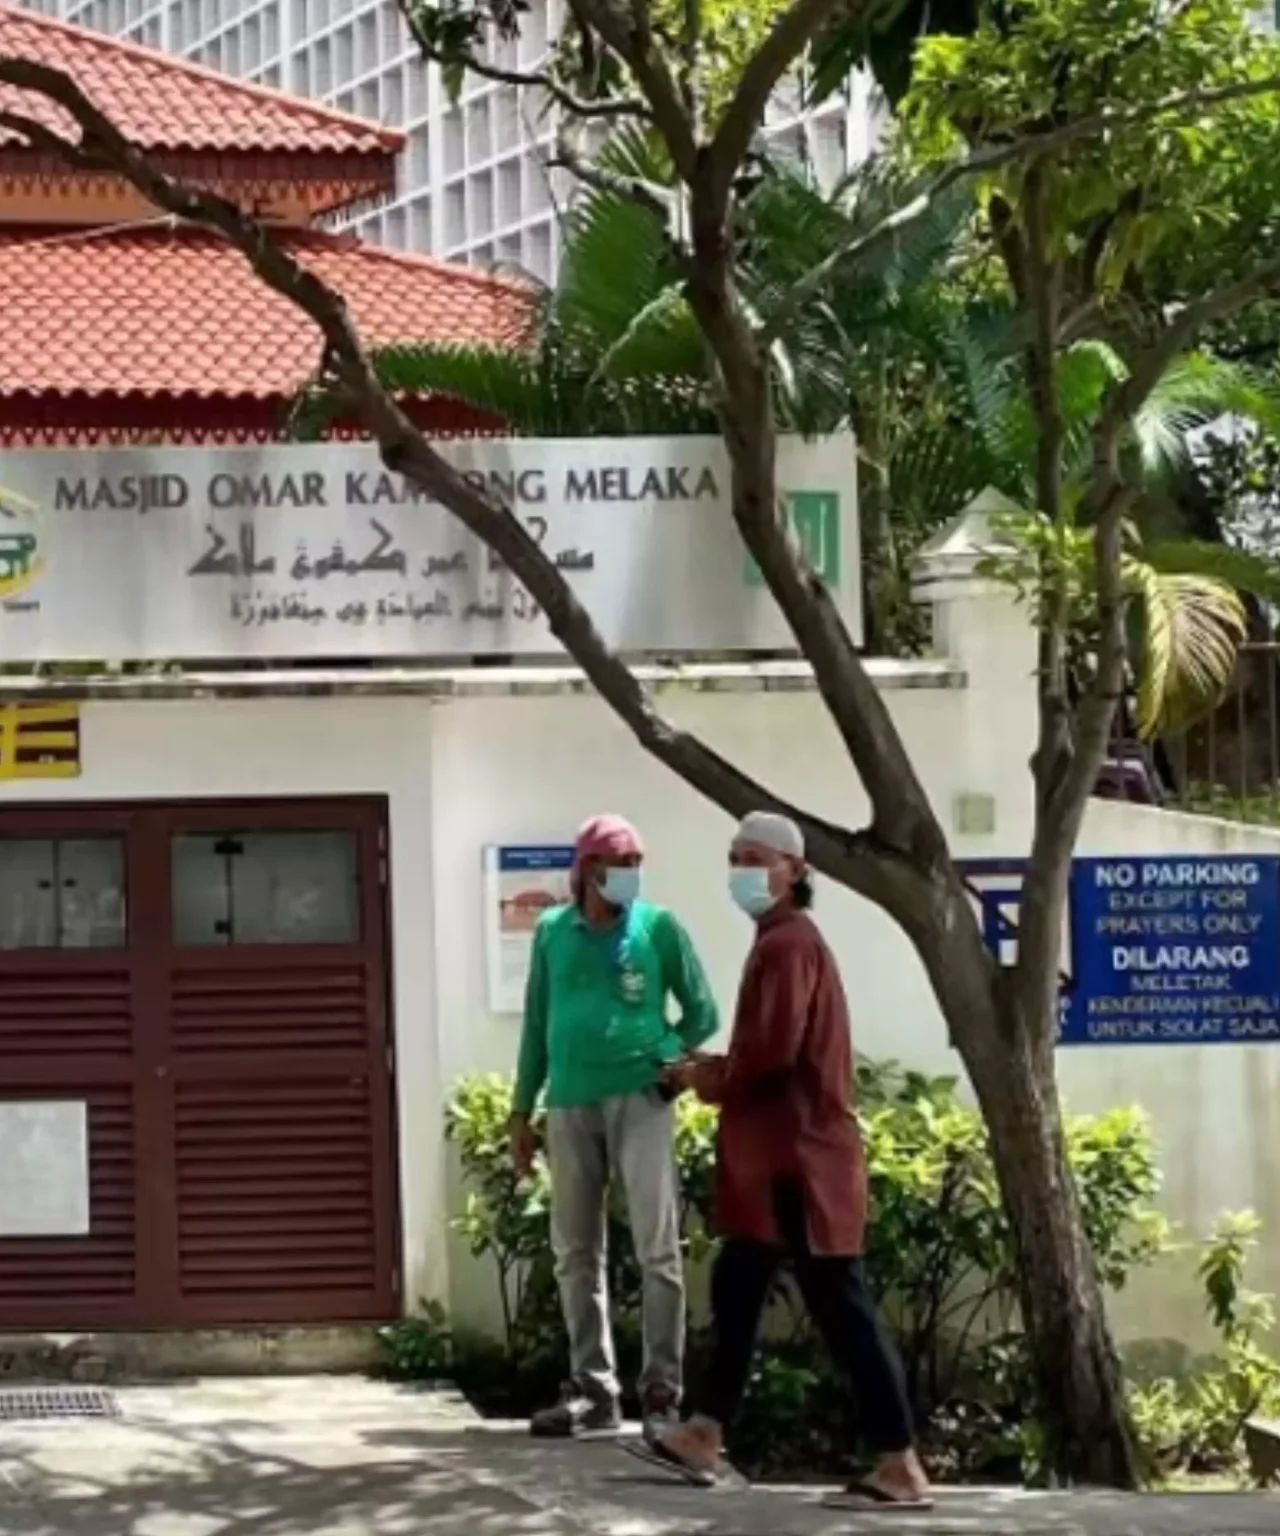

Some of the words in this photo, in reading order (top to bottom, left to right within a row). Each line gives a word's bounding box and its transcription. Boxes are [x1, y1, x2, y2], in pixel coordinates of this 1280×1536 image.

[55, 473, 189, 513] MASJID
[207, 472, 327, 507] OMAR
[345, 469, 546, 505] KAMONG
[565, 465, 720, 501] MELAKA
[1095, 865, 1137, 887] NO
[1143, 863, 1261, 886] PARKING
[1109, 890, 1195, 911] EXCEPT
[1202, 889, 1247, 909] FOR
[1096, 915, 1198, 936] PRAYERS
[1203, 914, 1263, 935] ONLY
[1112, 946, 1251, 971] DILARANG
[1131, 975, 1232, 991] MELETAK
